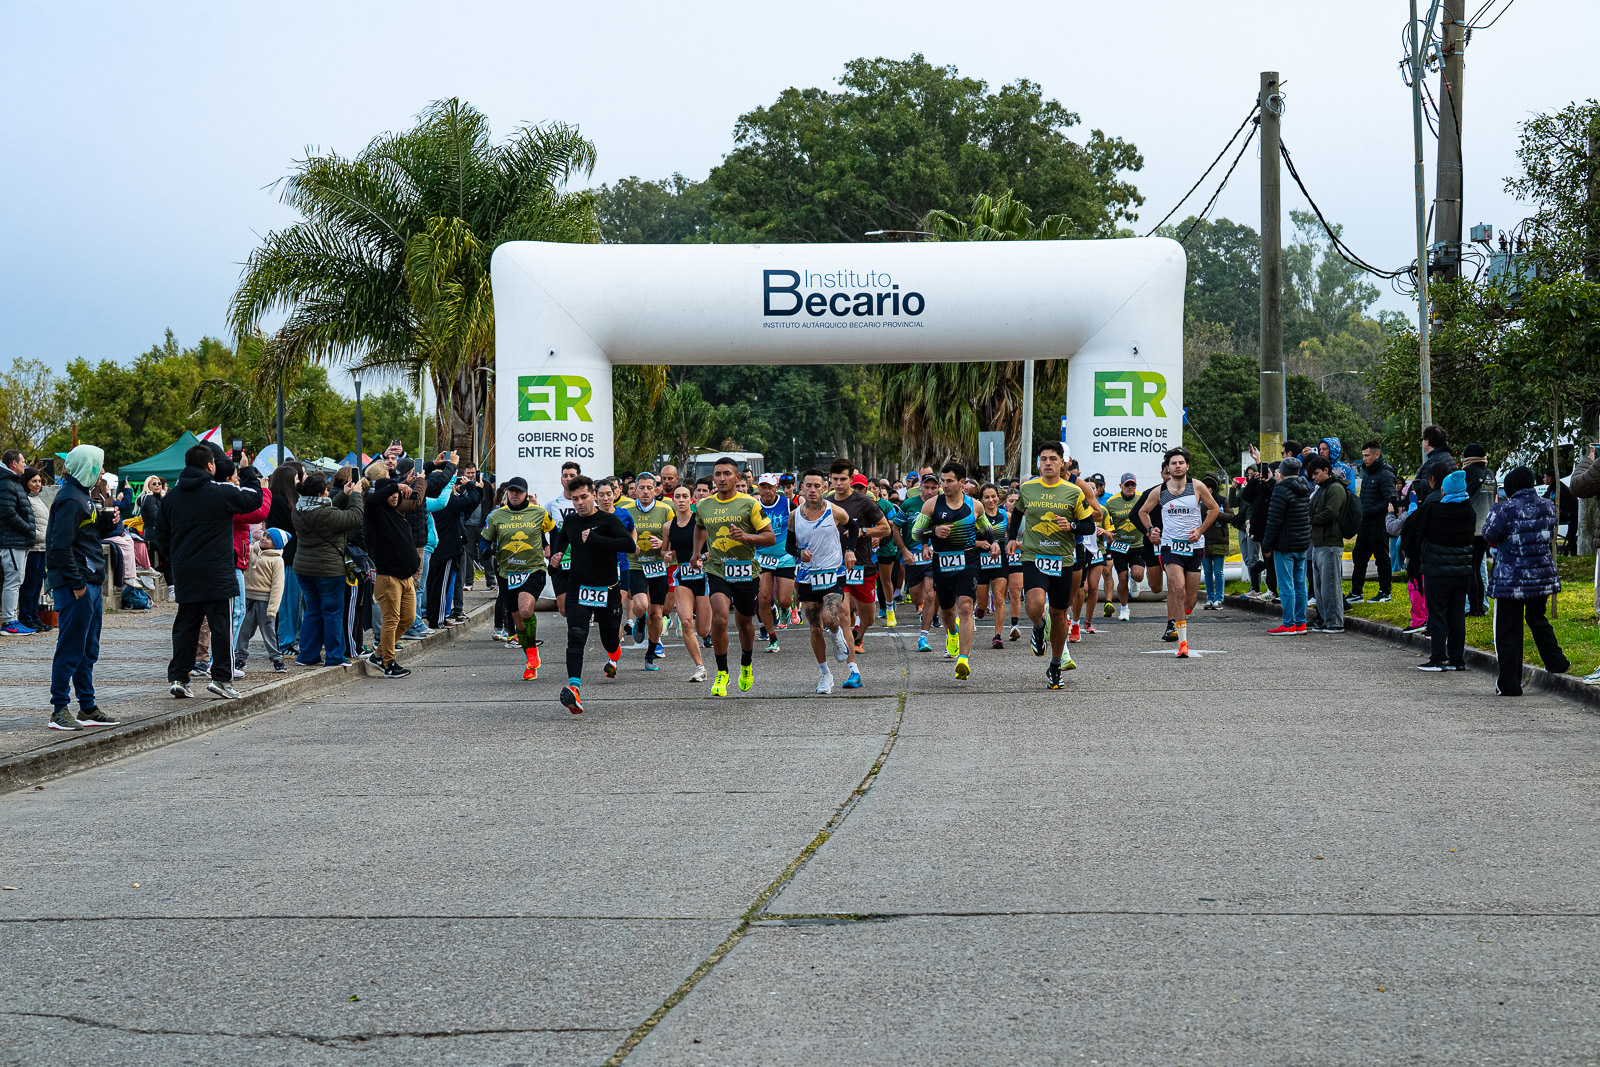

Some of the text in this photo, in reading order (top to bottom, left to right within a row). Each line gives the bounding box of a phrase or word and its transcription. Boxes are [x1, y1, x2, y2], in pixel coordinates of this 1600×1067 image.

[805, 269, 892, 288] Instituto
[763, 269, 926, 317] Becario
[801, 320, 848, 329] AUTÁRQUICO
[882, 320, 925, 328] PROVINCIAL
[518, 375, 593, 422] ER
[1094, 371, 1167, 418] ER
[517, 432, 594, 443] GOBIERNO DE
[1092, 427, 1168, 438] GOBIERNO DE
[518, 444, 595, 458] ENTRE RÍOS
[1092, 439, 1168, 453] ENTRE RÍOS
[1028, 501, 1069, 510] ANIVERSARIO
[1172, 541, 1192, 552] 095
[760, 555, 778, 567] 109
[941, 554, 962, 567] 021
[1036, 557, 1060, 572] 034
[644, 561, 665, 576] 088
[726, 564, 750, 578] 035
[509, 572, 529, 586] 037
[812, 571, 835, 586] 117
[580, 587, 606, 603] 036
